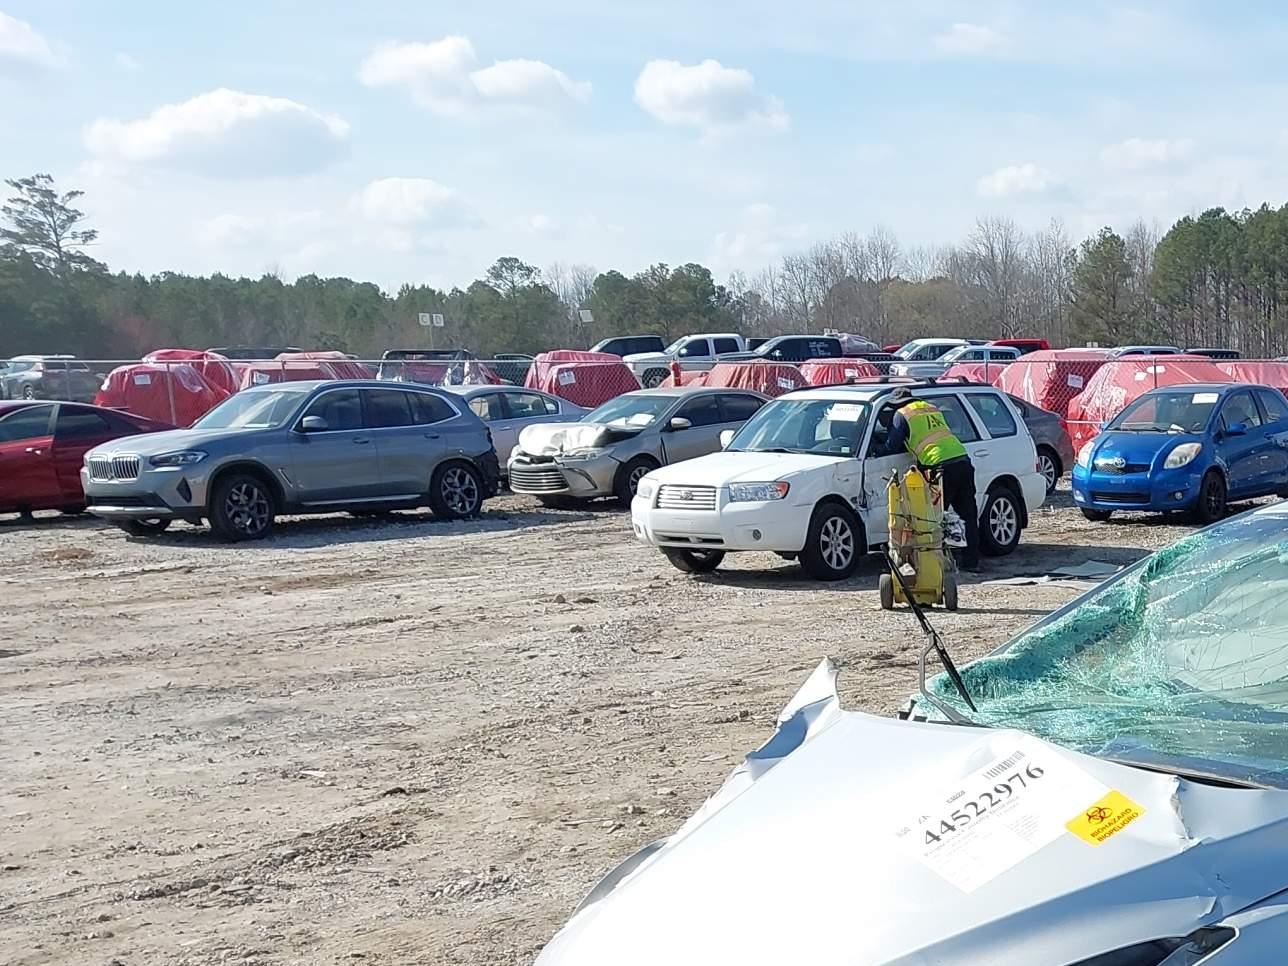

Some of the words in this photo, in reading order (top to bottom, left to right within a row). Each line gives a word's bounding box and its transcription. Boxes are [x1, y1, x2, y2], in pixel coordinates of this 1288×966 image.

[925, 762, 1045, 845] 44522976
[1090, 808, 1132, 838] BIOHAZARD
[1096, 811, 1139, 842] BIOPELIGRO
